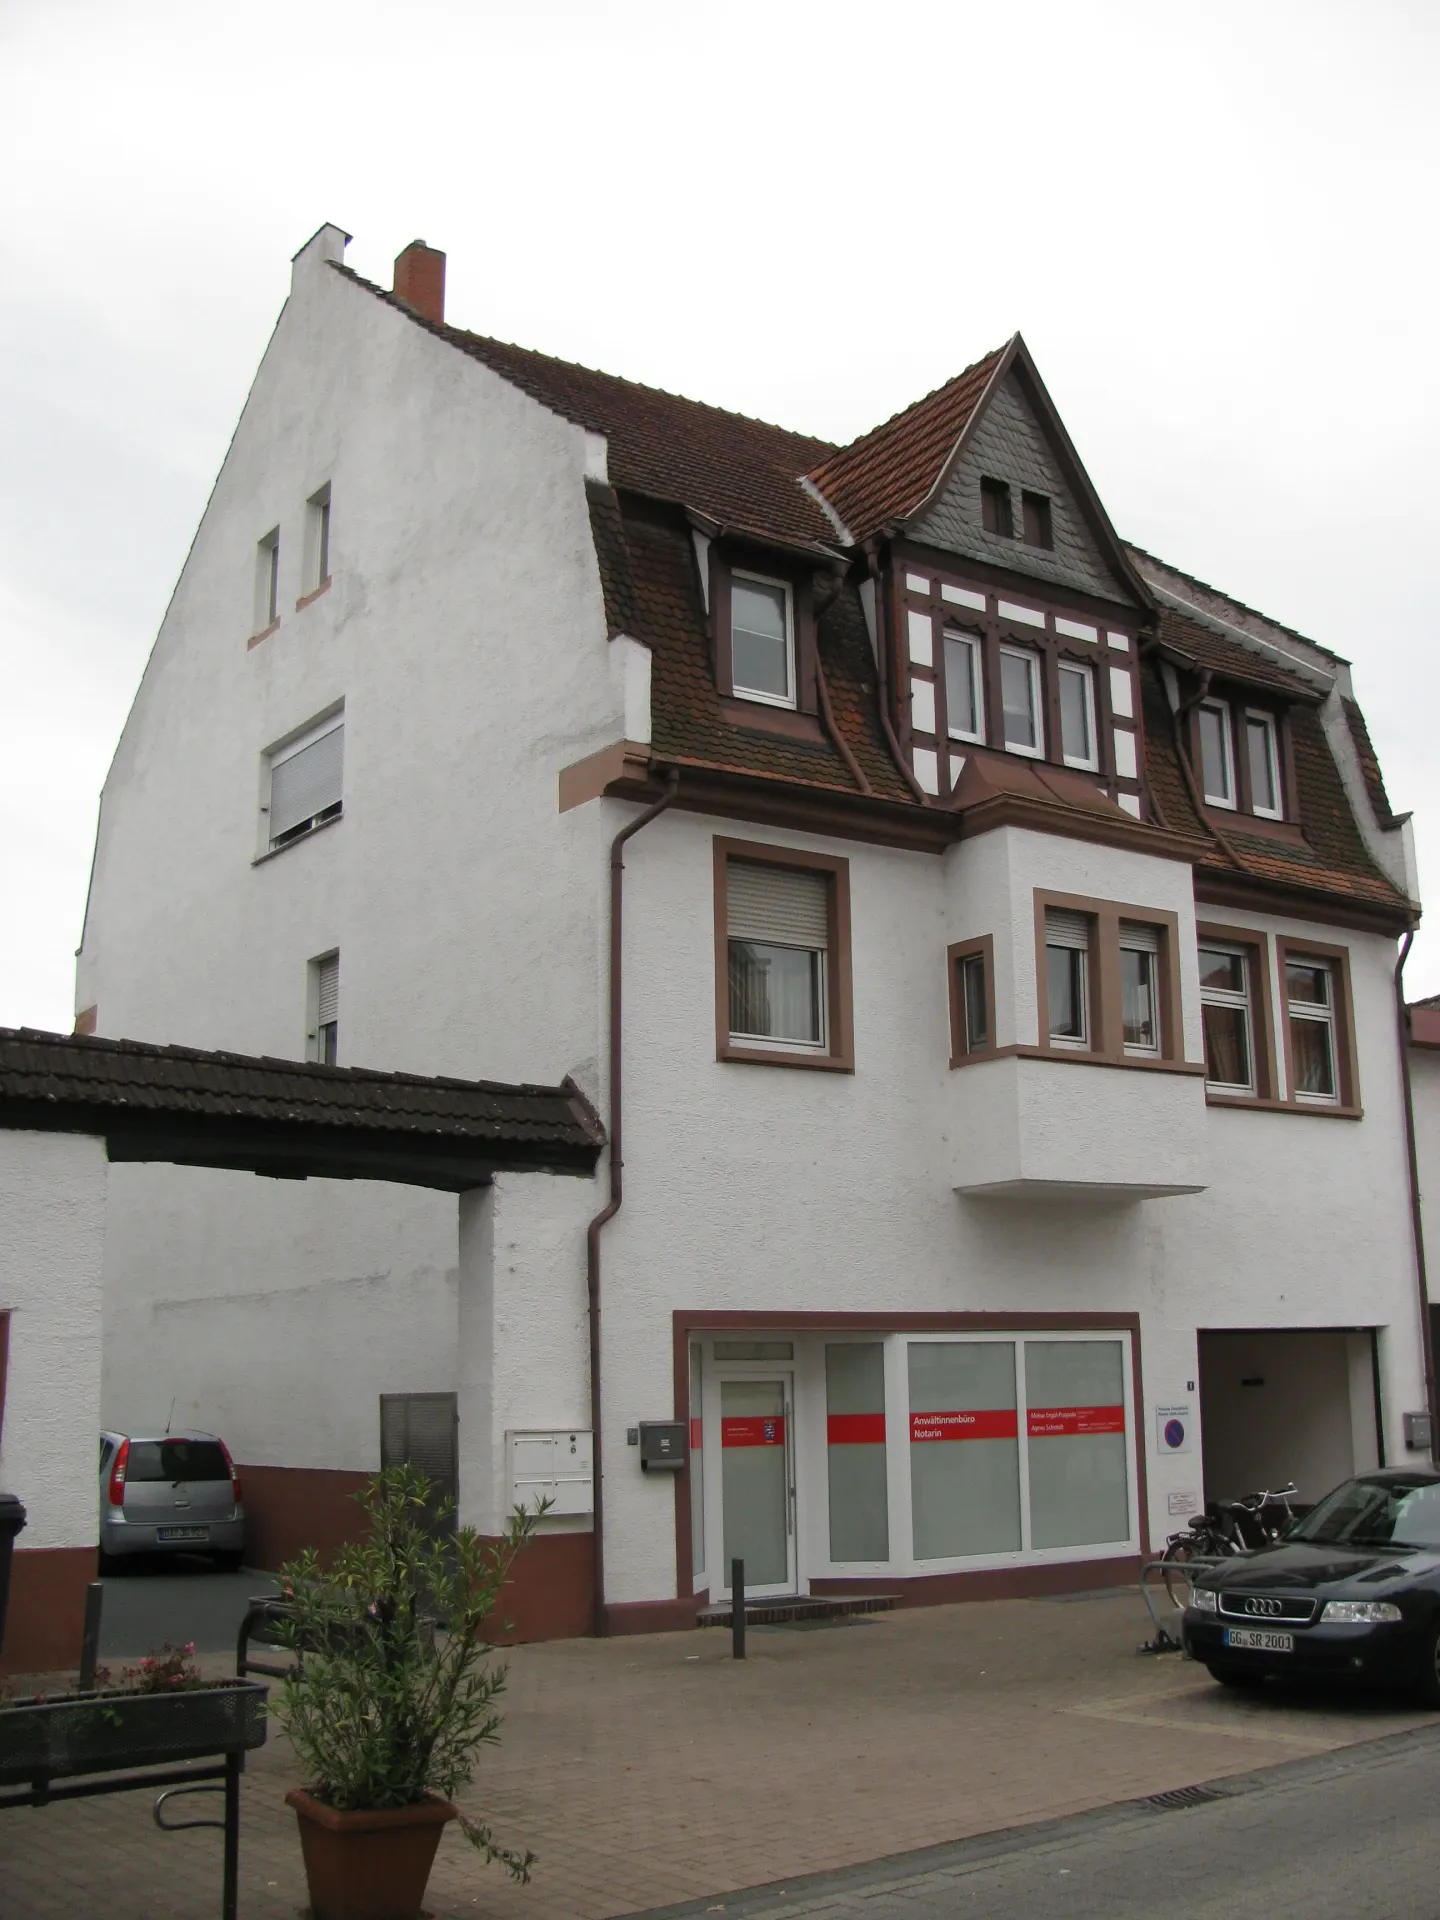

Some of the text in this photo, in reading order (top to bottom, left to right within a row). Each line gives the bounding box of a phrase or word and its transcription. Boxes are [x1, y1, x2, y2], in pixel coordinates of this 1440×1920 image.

[914, 1414, 975, 1425] Anwältinnenbüro
[914, 1428, 942, 1438] Notarin
[1230, 1631, 1291, 1649] GG SR 2001
